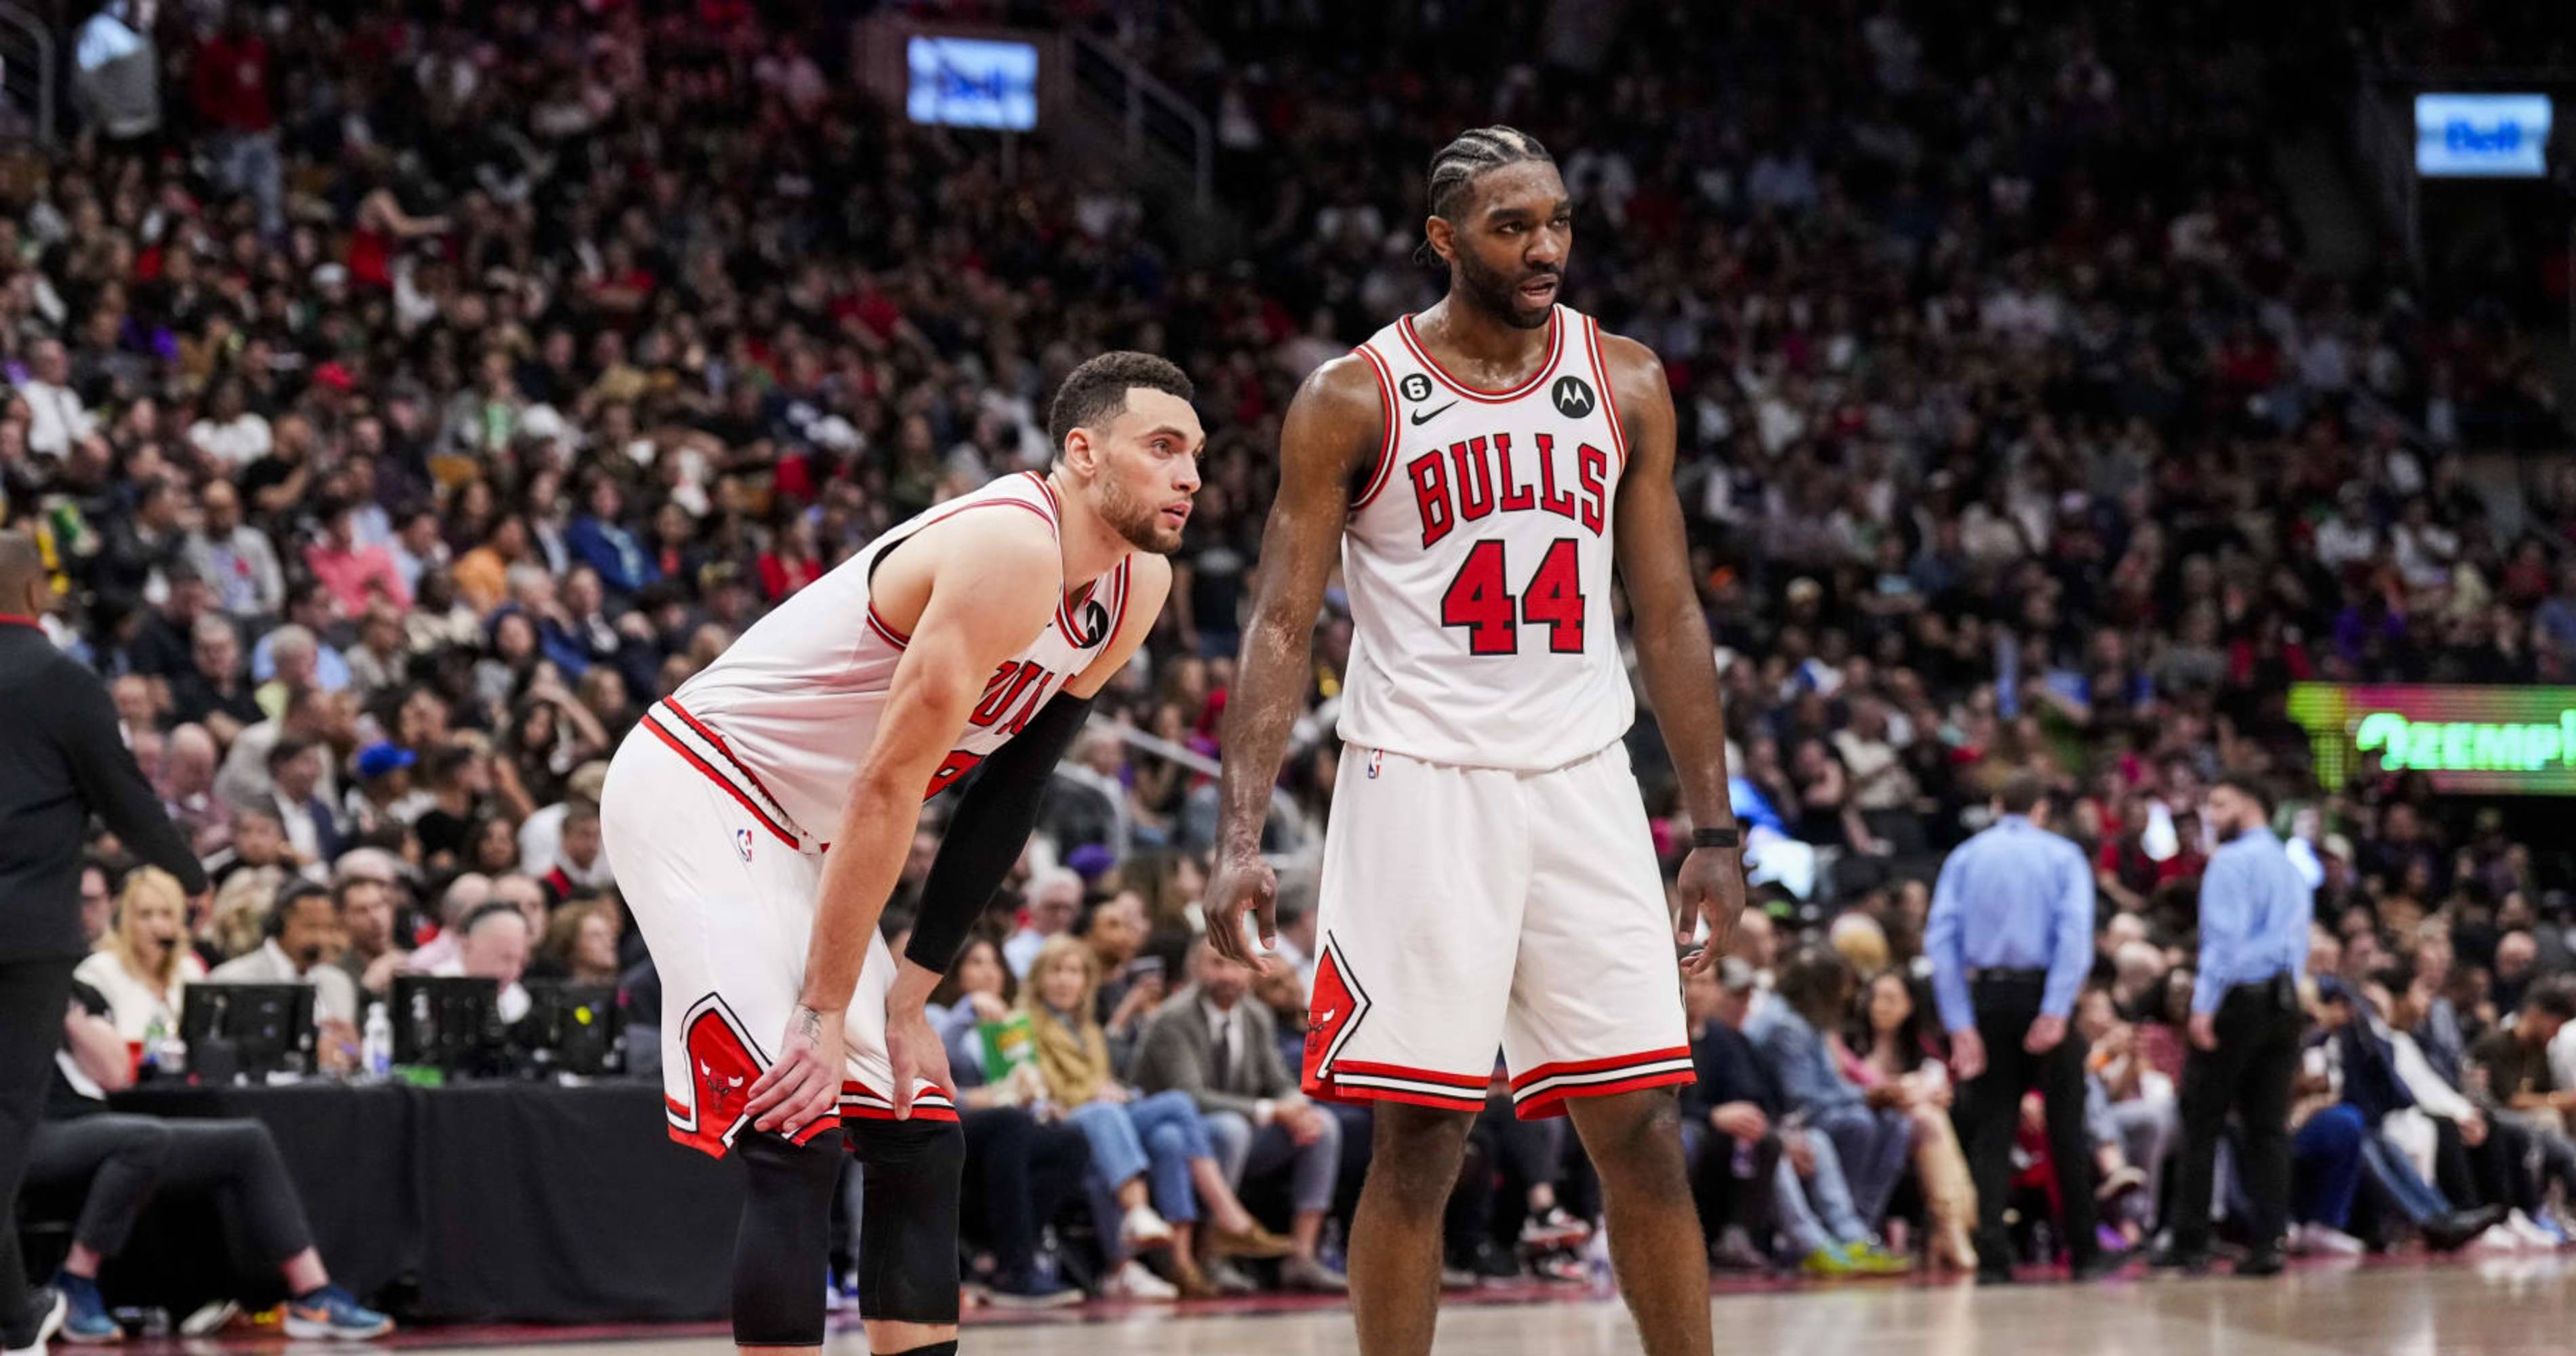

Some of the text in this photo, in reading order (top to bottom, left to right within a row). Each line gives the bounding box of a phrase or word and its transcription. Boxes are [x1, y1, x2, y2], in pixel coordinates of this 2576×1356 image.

[1407, 377, 1426, 399] 6
[1407, 433, 1607, 550] BULLS
[1441, 538, 1585, 656] 44
